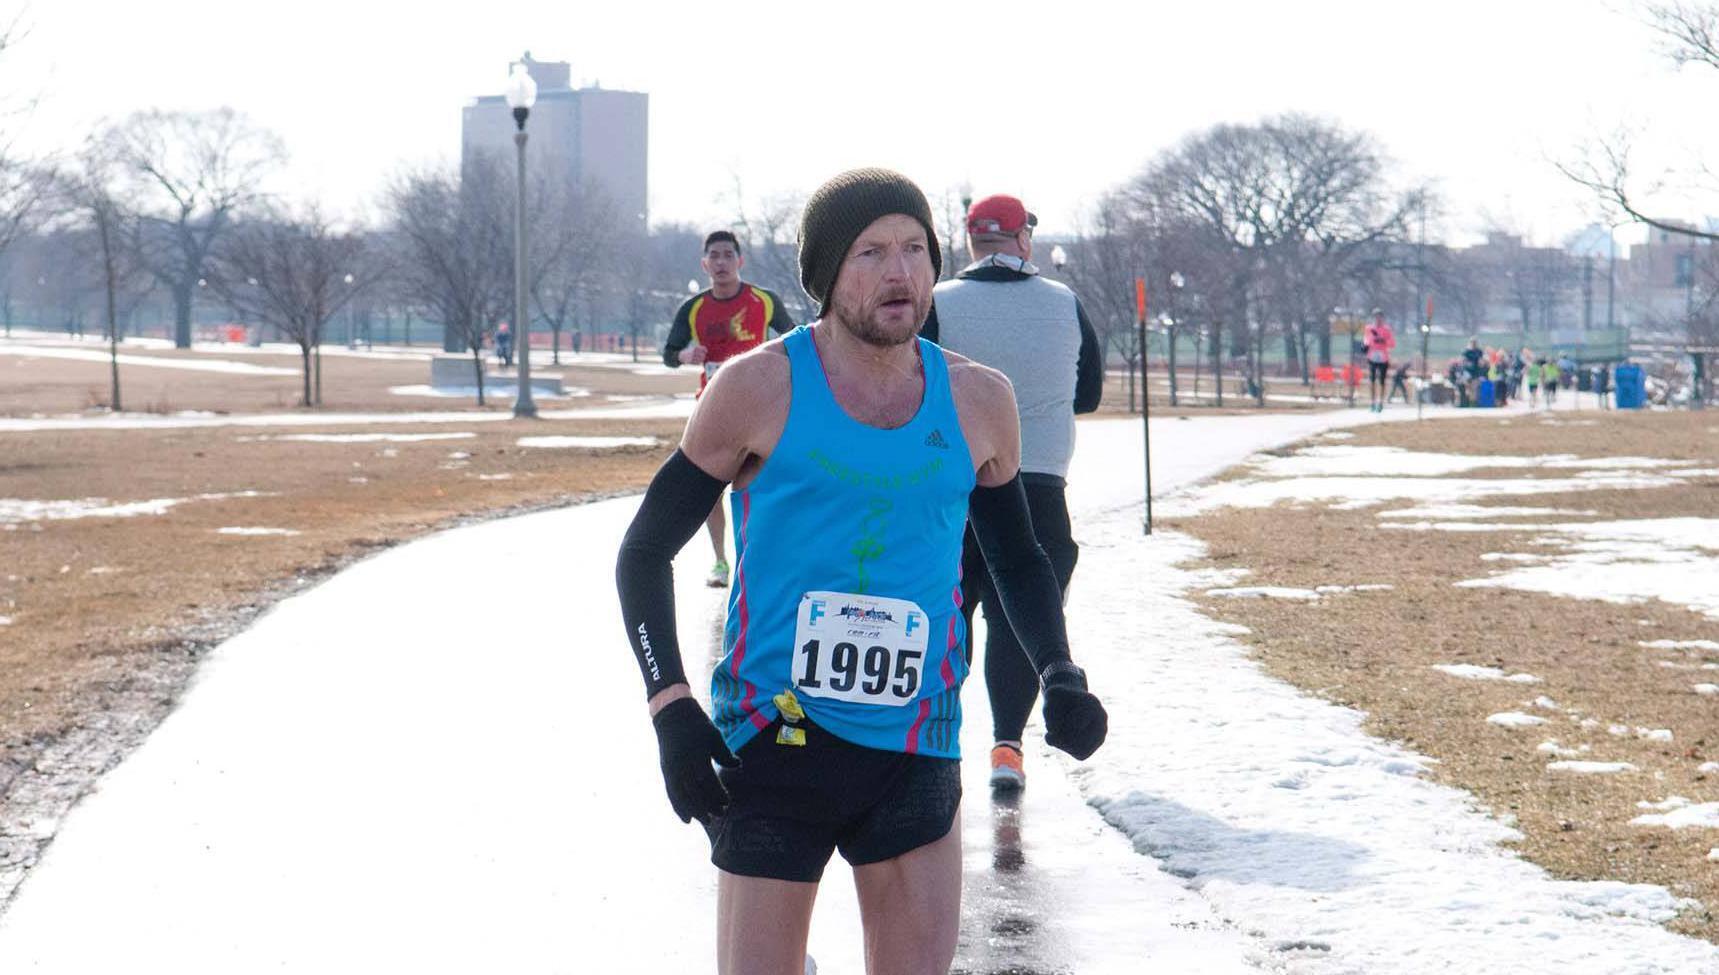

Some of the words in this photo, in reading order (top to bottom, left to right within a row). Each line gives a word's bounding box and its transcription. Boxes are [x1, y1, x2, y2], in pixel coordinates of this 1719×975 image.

[809, 602, 826, 626] F
[905, 613, 921, 637] F
[638, 622, 661, 681] ALTURA
[798, 639, 922, 698] 1995
